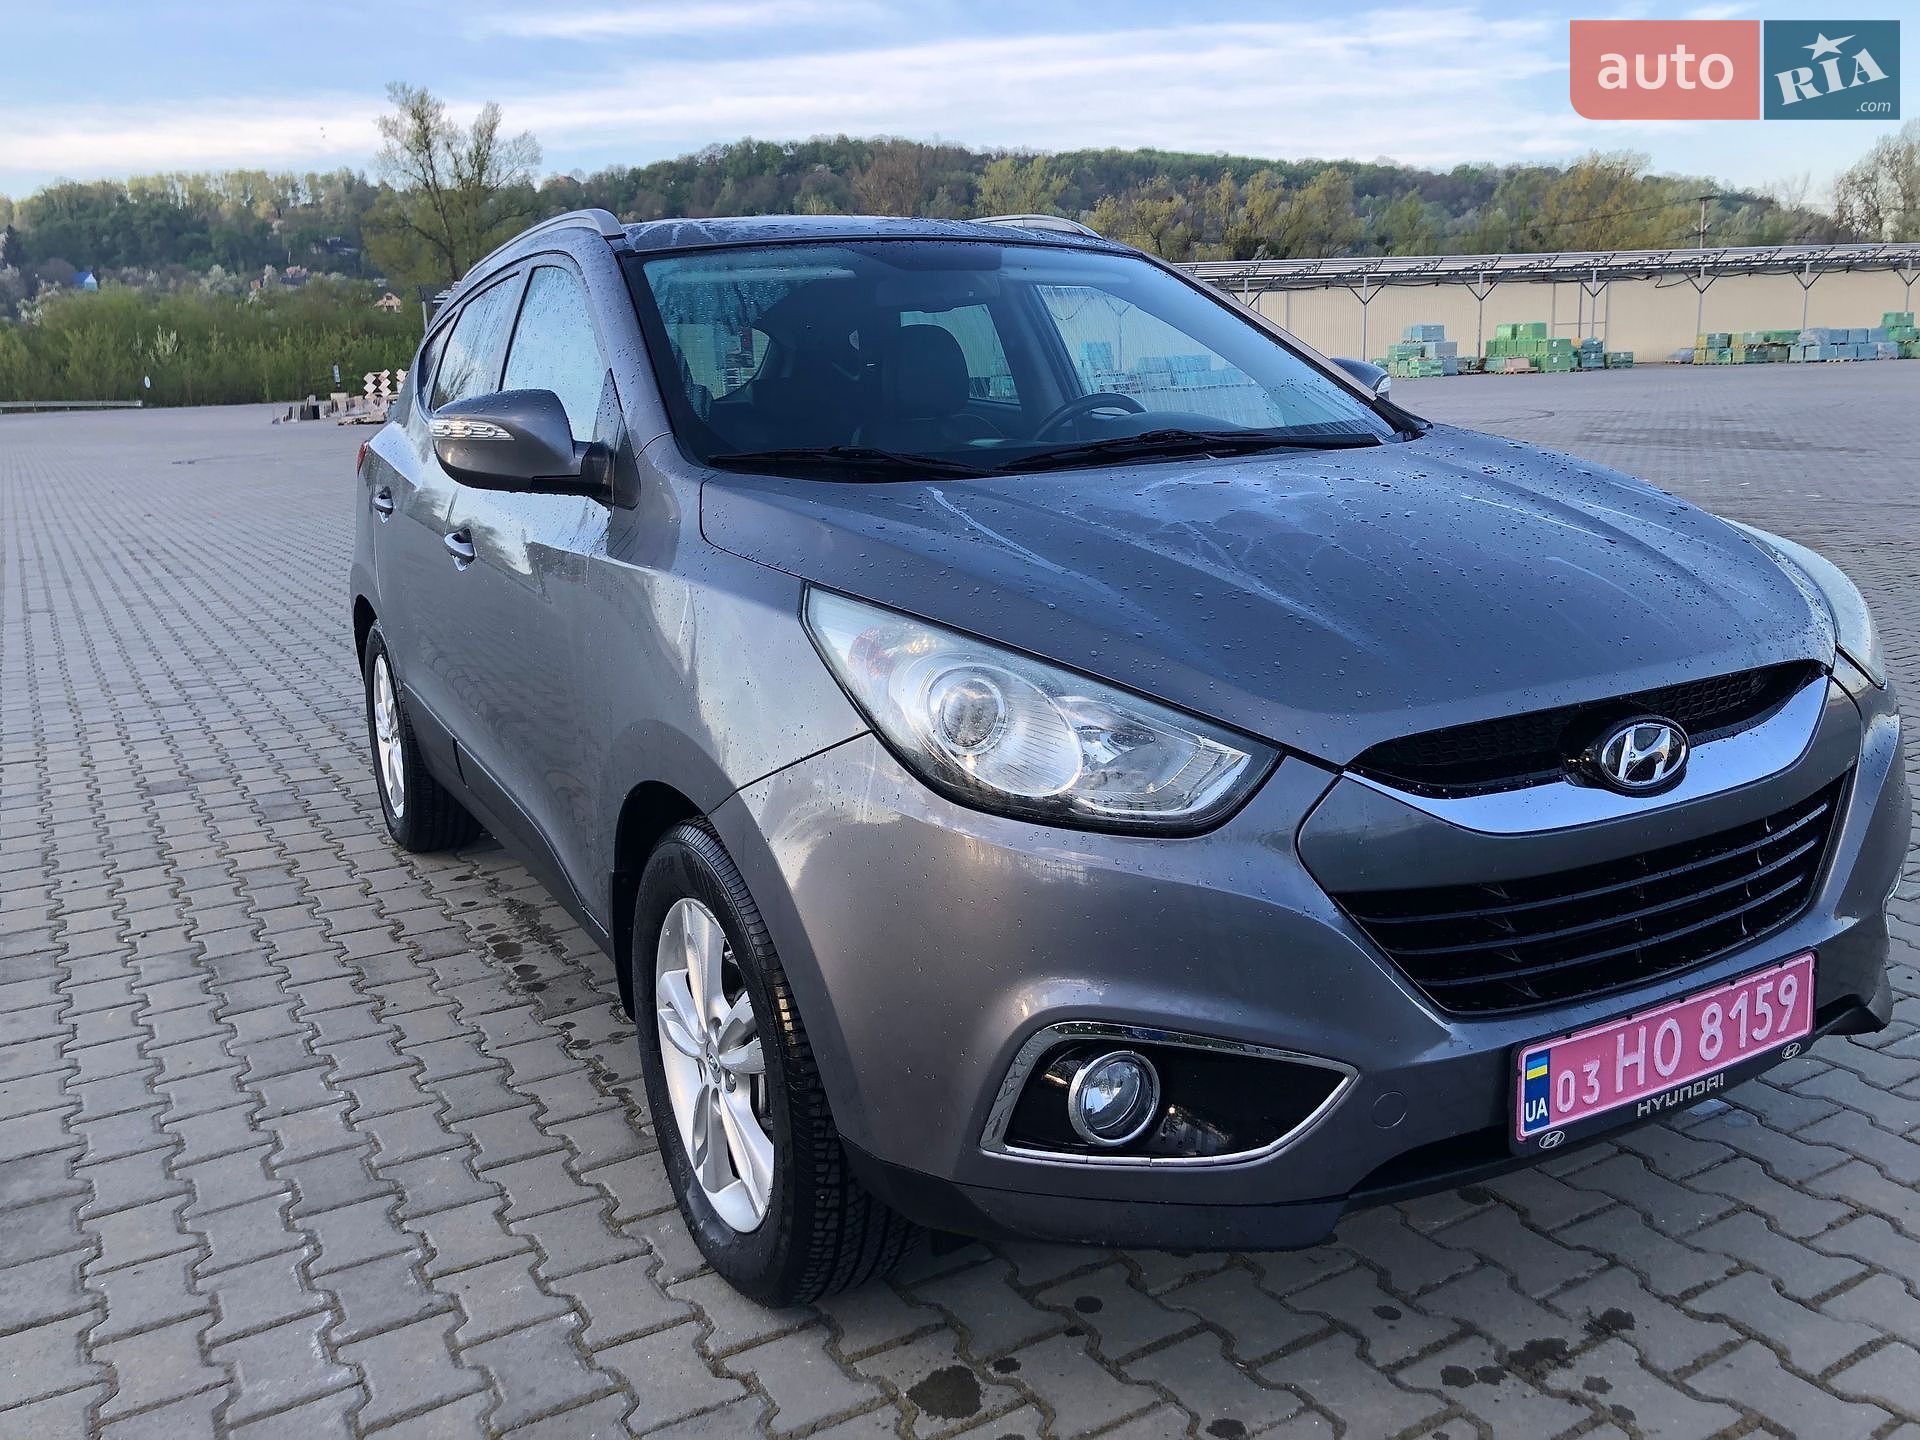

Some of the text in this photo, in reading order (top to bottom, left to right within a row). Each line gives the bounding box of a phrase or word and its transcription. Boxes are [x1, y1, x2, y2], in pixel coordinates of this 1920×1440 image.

[1556, 974, 1799, 1113] 03 HO 8159
[1525, 1097, 1549, 1122] UA
[1637, 1072, 1725, 1117] HYUNDAI
